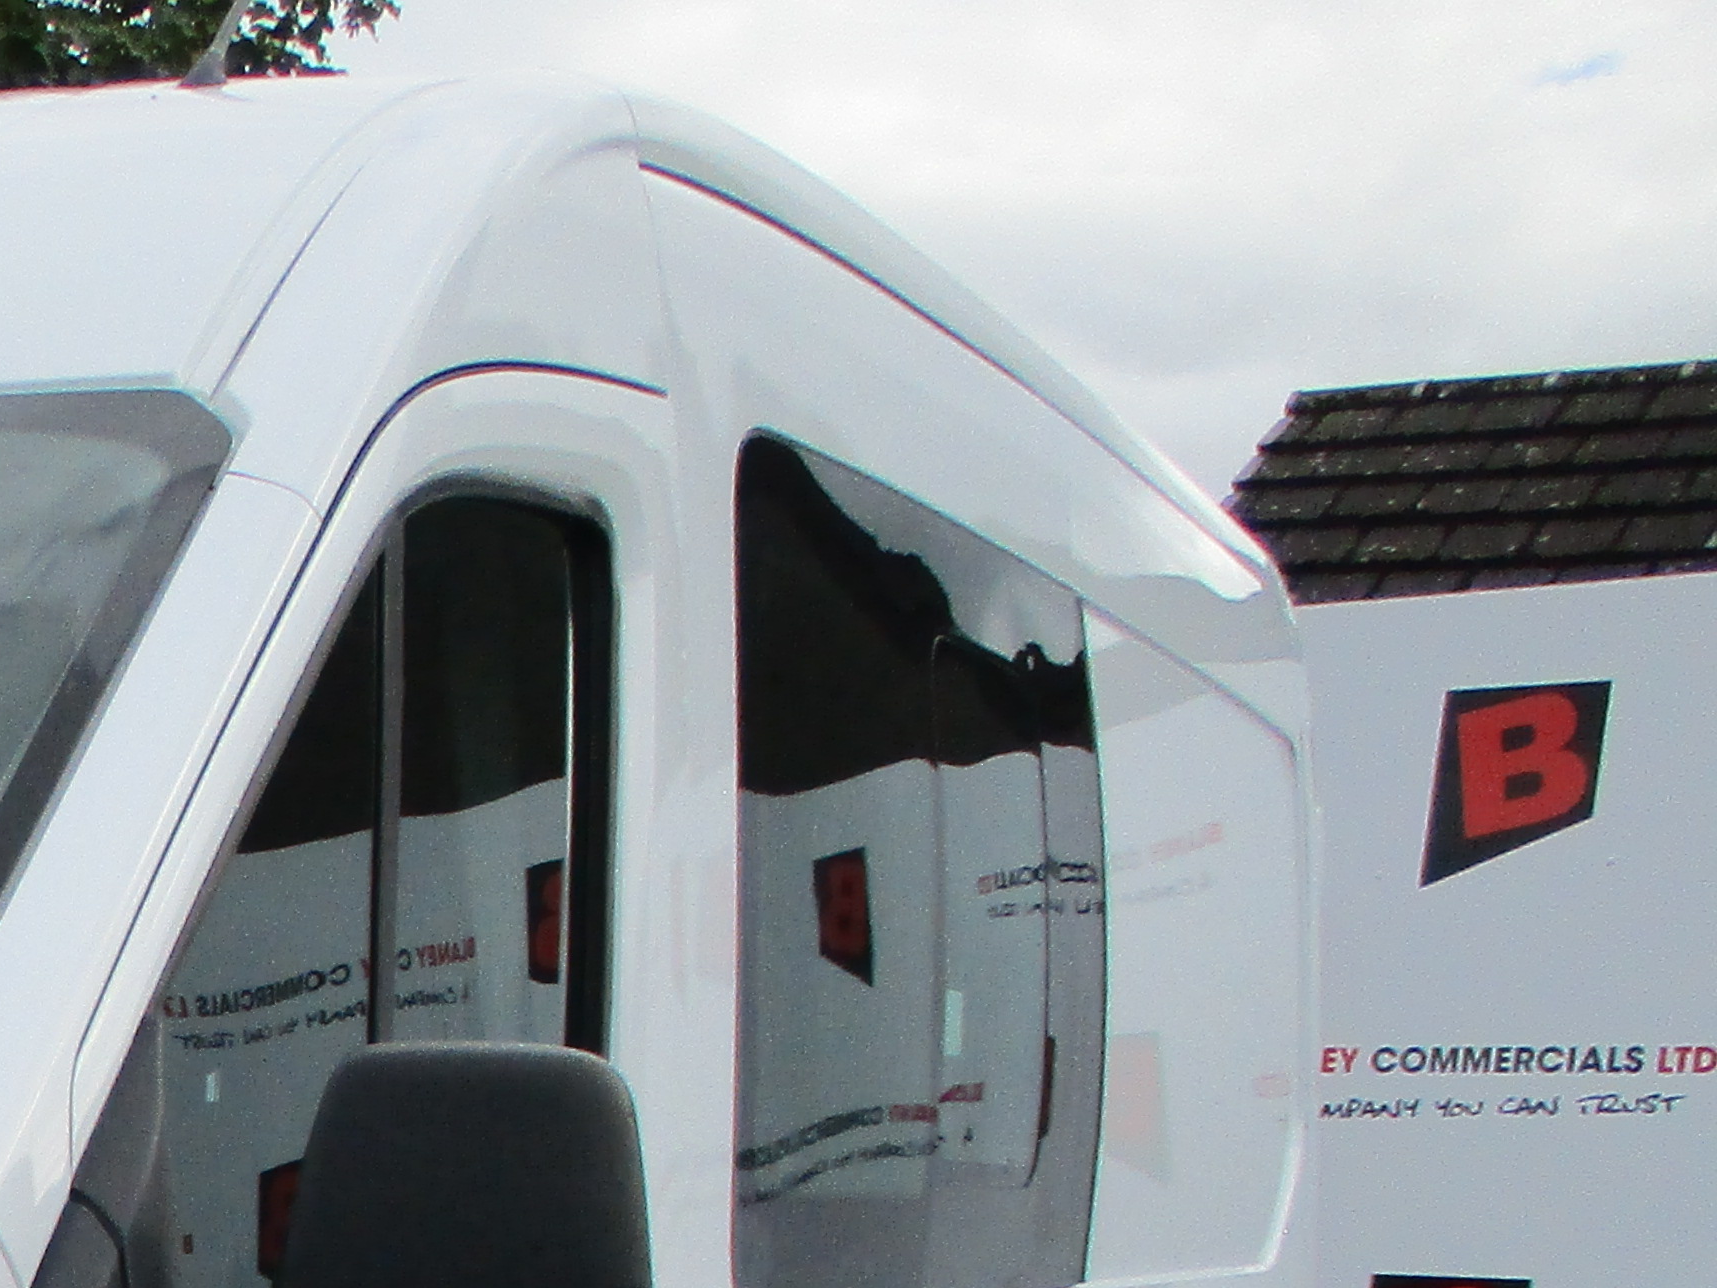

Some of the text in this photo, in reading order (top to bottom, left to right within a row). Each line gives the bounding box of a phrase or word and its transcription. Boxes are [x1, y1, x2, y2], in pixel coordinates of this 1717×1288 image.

[1457, 691, 1589, 839] B
[1320, 1045, 1717, 1074] EY COMMERCIALS LTD
[1434, 1097, 1484, 1118] YOU
[1496, 1096, 1561, 1117] CAN
[1575, 1091, 1687, 1115] TRUST
